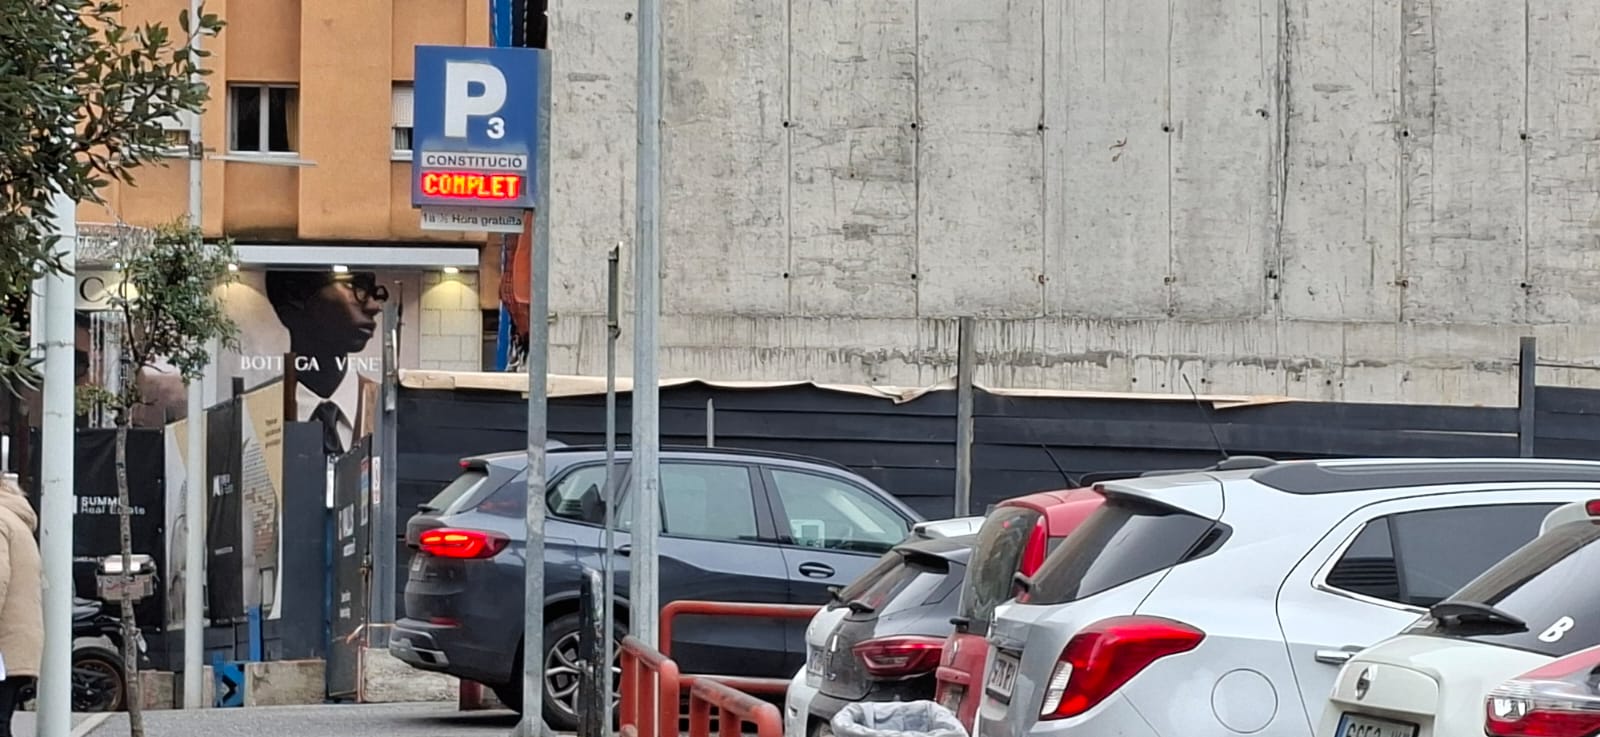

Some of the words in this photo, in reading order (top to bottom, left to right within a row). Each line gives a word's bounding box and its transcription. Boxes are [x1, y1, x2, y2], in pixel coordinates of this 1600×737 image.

[445, 61, 507, 138] P
[486, 117, 505, 139] 3
[426, 153, 522, 168] CONSTITUCIÓ
[424, 174, 519, 197] COMPLET
[452, 213, 478, 224] Hora
[240, 355, 320, 371] BOTTGA
[335, 355, 380, 371] VENE
[81, 505, 105, 514] Real
[1538, 616, 1574, 642] B
